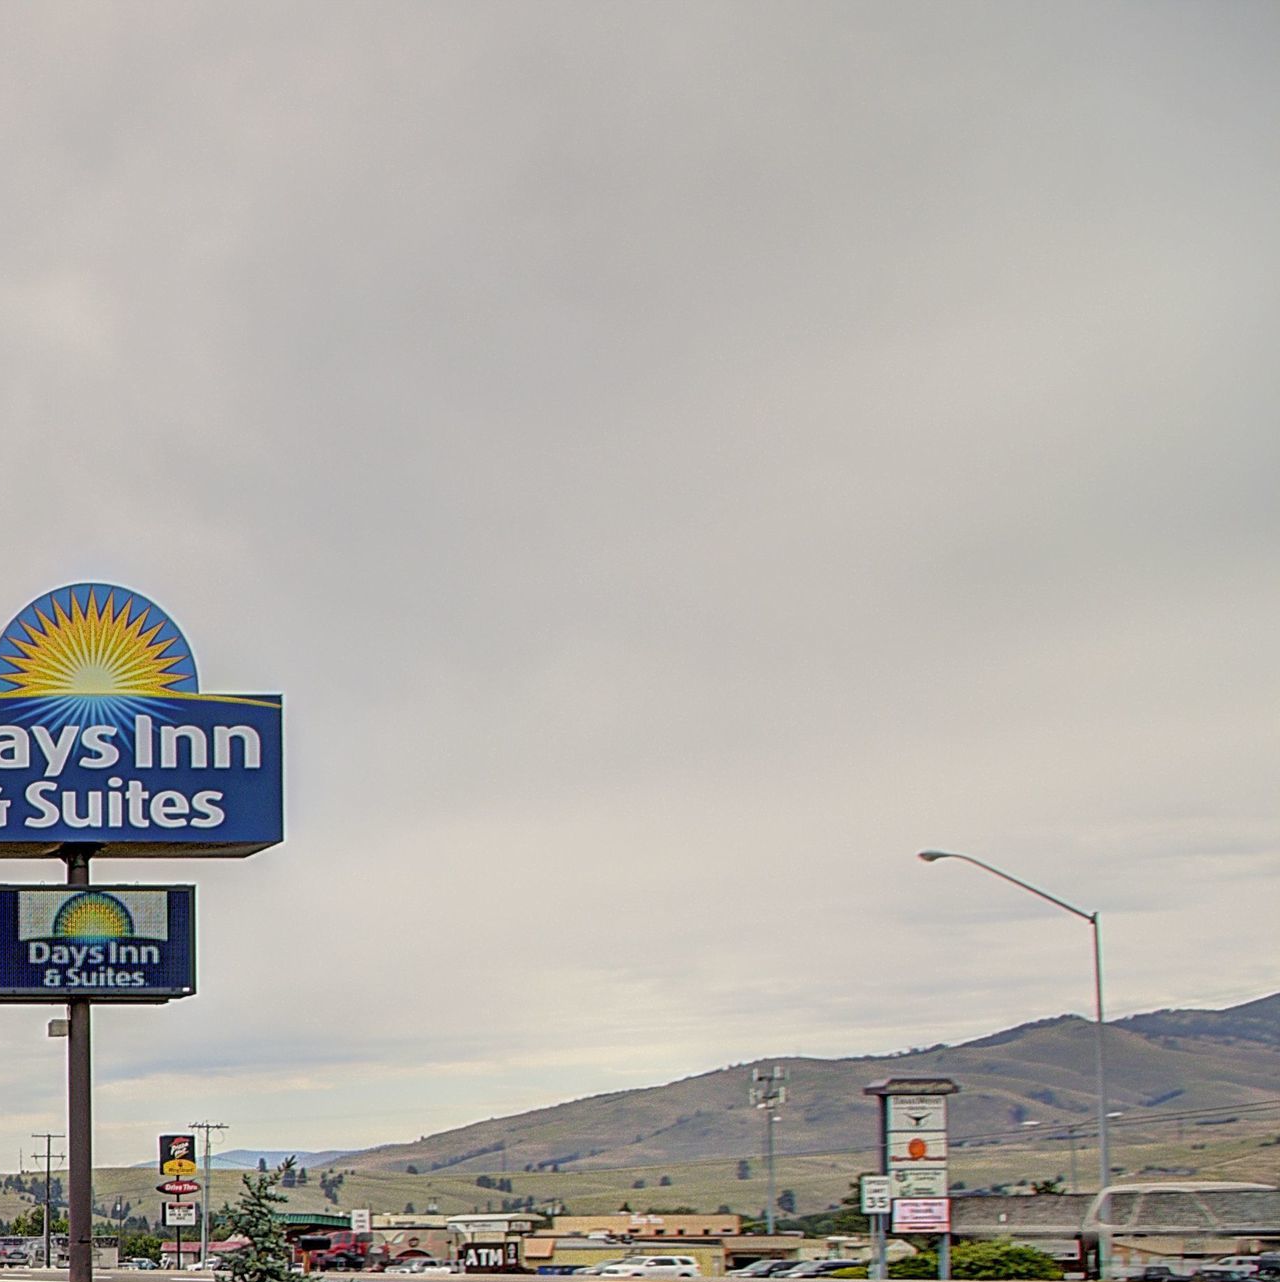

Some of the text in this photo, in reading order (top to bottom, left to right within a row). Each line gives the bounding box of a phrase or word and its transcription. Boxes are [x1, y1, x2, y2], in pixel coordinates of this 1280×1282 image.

[134, 714, 261, 769] Inn
[23, 776, 225, 829] Suites
[28, 941, 160, 968] Days Inn
[43, 966, 144, 987] & Suites
[866, 1196, 889, 1208] 35
[465, 1248, 503, 1266] ATM
